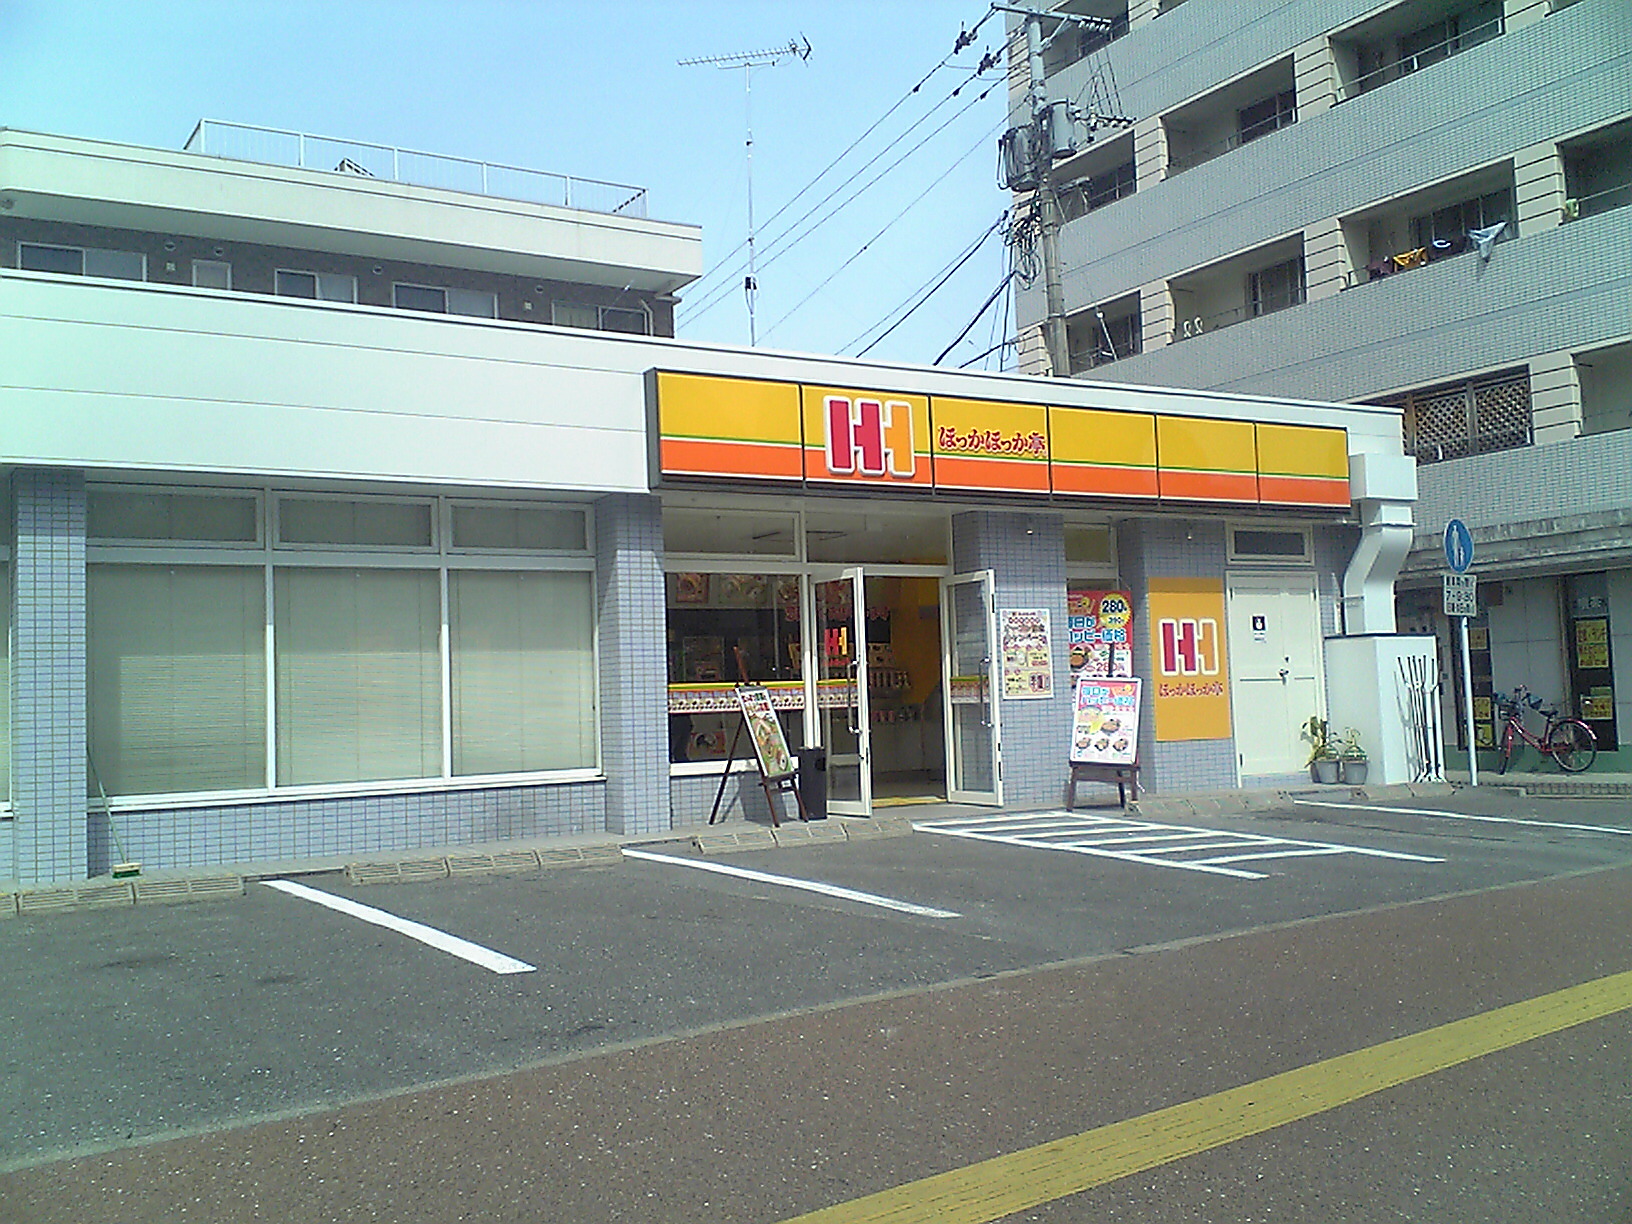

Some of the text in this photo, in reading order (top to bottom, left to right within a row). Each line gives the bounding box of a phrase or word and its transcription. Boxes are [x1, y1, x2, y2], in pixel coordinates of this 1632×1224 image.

[938, 426, 1046, 456] ほっかほっか亭
